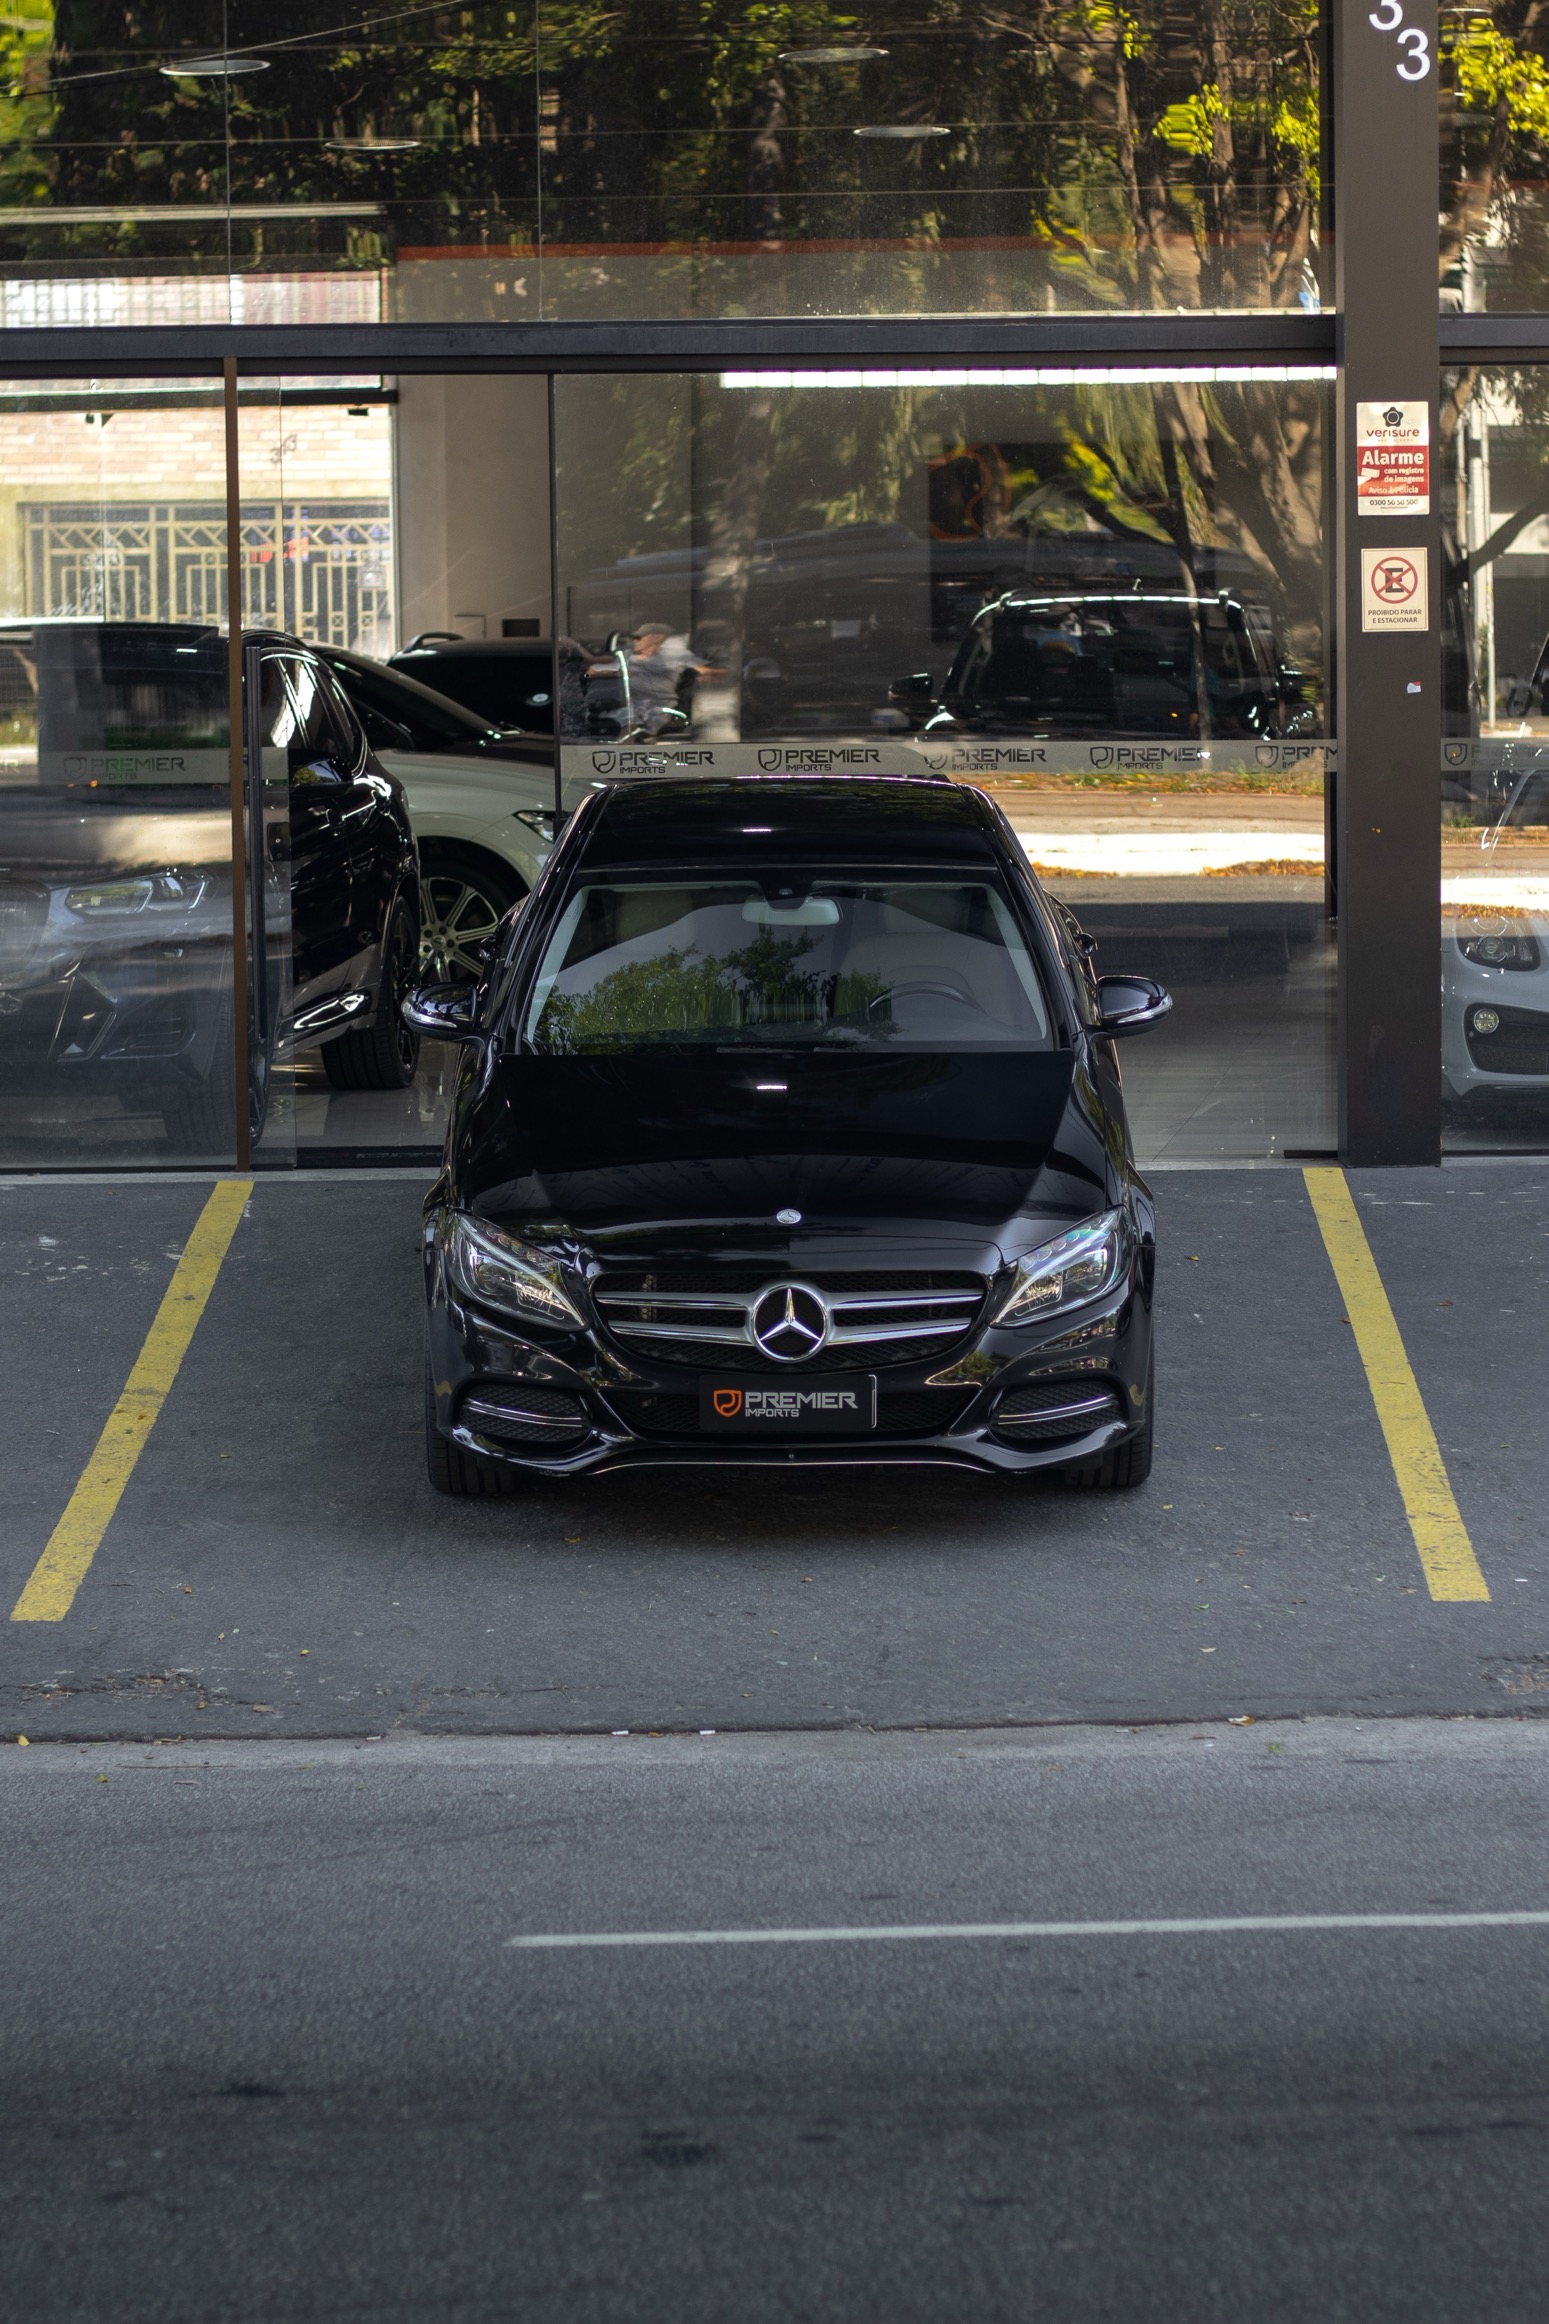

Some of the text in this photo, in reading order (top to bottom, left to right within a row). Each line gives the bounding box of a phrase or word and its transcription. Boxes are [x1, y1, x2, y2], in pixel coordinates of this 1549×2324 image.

[1366, 428, 1420, 437] verisure
[1362, 450, 1424, 466] Alarme
[1398, 467, 1424, 476] registro
[1394, 475, 1424, 484] imagens
[619, 750, 715, 766] PREMIER
[785, 749, 882, 763] PREMIER
[951, 748, 1048, 763] PREMIER
[90, 757, 186, 772] PREMIER
[785, 763, 832, 771] IMPORTS
[951, 762, 998, 770] IMPORTS
[619, 766, 666, 774] IMPORTS
[745, 1391, 858, 1408] PREMIER
[745, 1408, 800, 1417] IMPORTS
